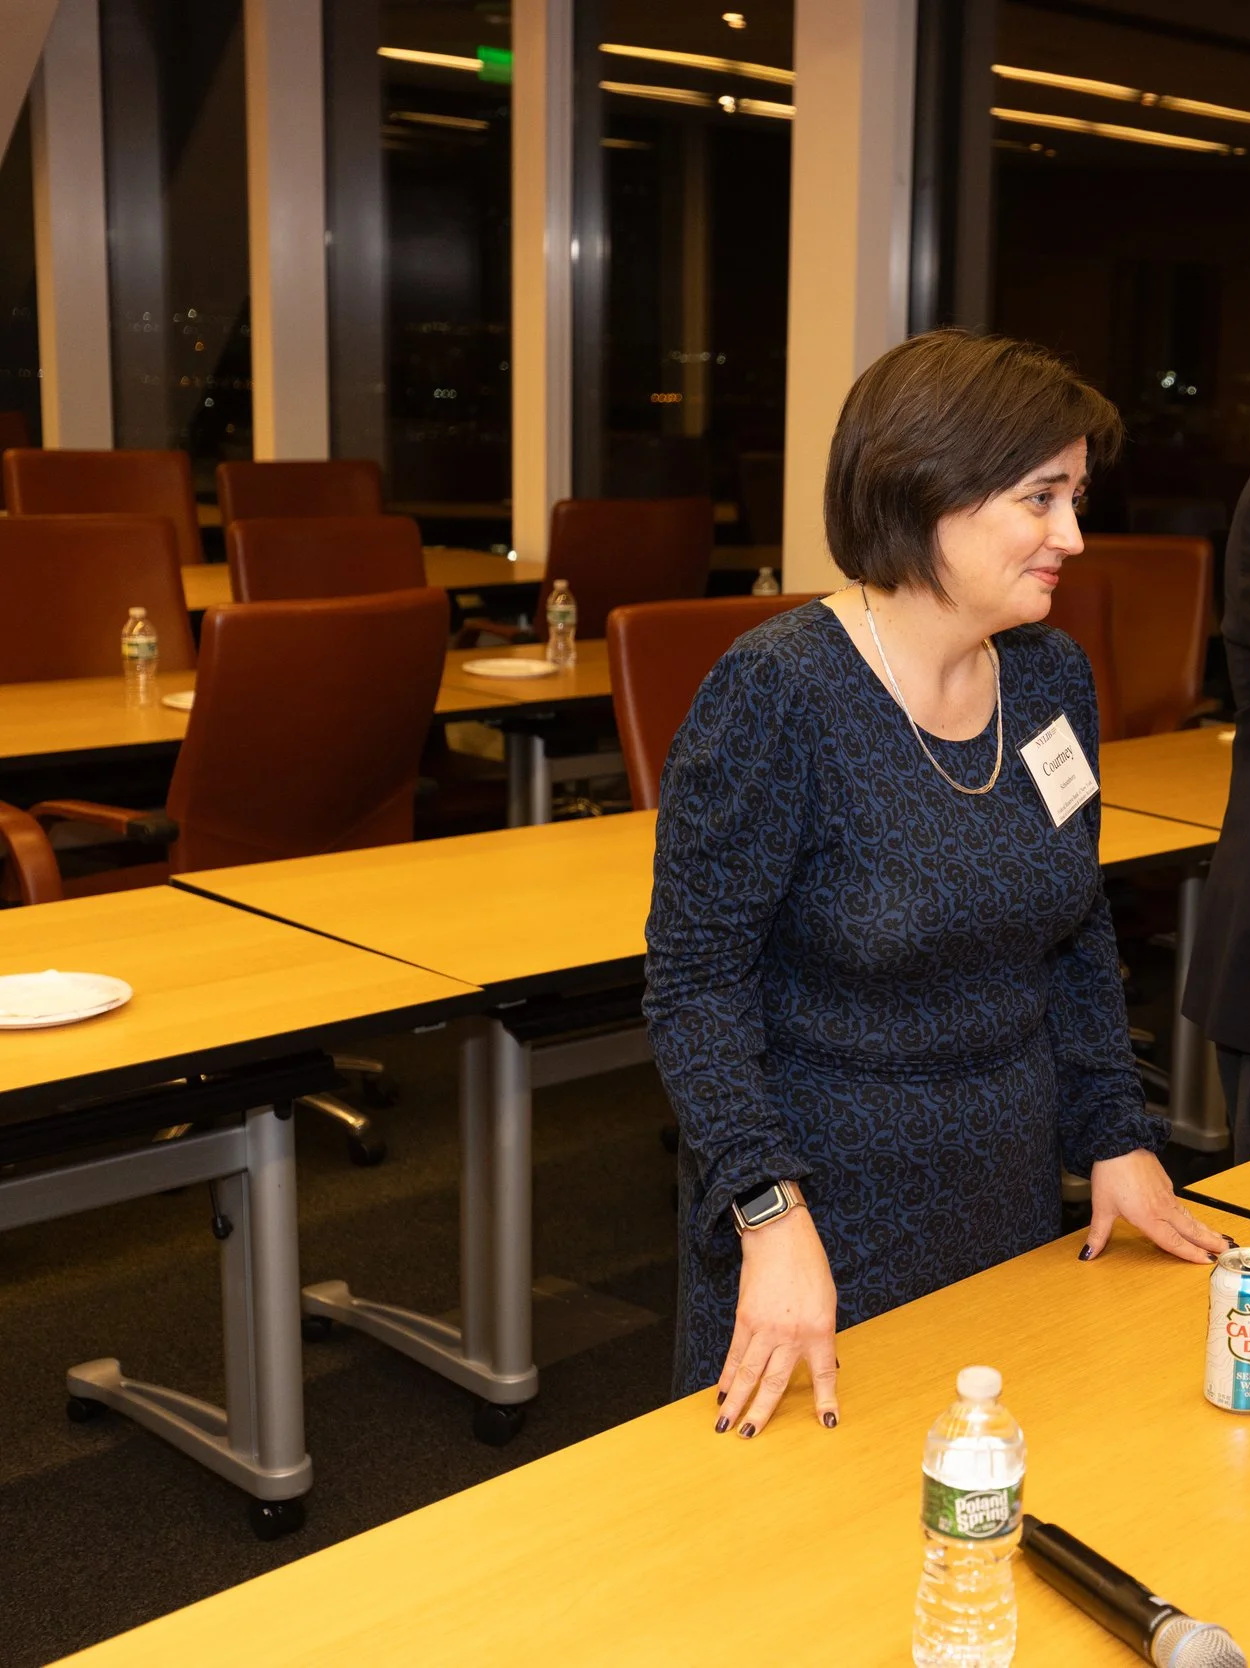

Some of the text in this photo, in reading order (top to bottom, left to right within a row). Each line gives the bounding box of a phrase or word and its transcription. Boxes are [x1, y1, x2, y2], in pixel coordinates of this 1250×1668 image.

[1042, 745, 1074, 777] Courtney
[955, 1489, 1009, 1514] Poland
[956, 1506, 1010, 1533] Spring
